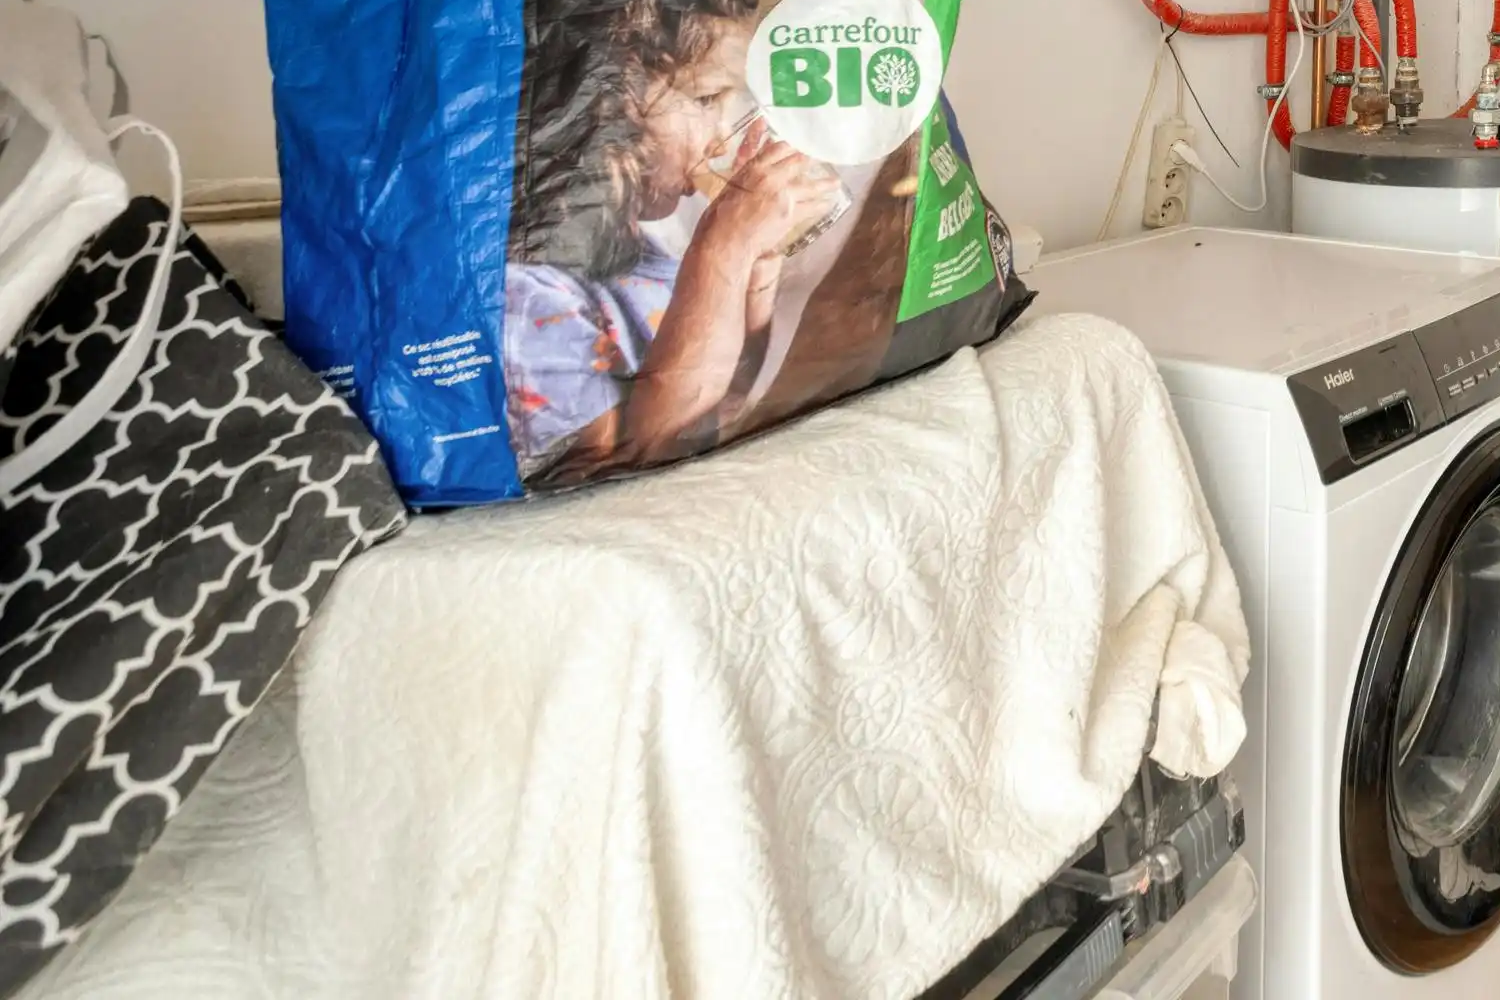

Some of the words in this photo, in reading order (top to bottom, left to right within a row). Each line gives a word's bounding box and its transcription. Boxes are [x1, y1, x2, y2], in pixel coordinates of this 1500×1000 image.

[769, 16, 922, 47] Carrefour
[769, 46, 921, 109] BIO
[1323, 367, 1355, 390] Haier
